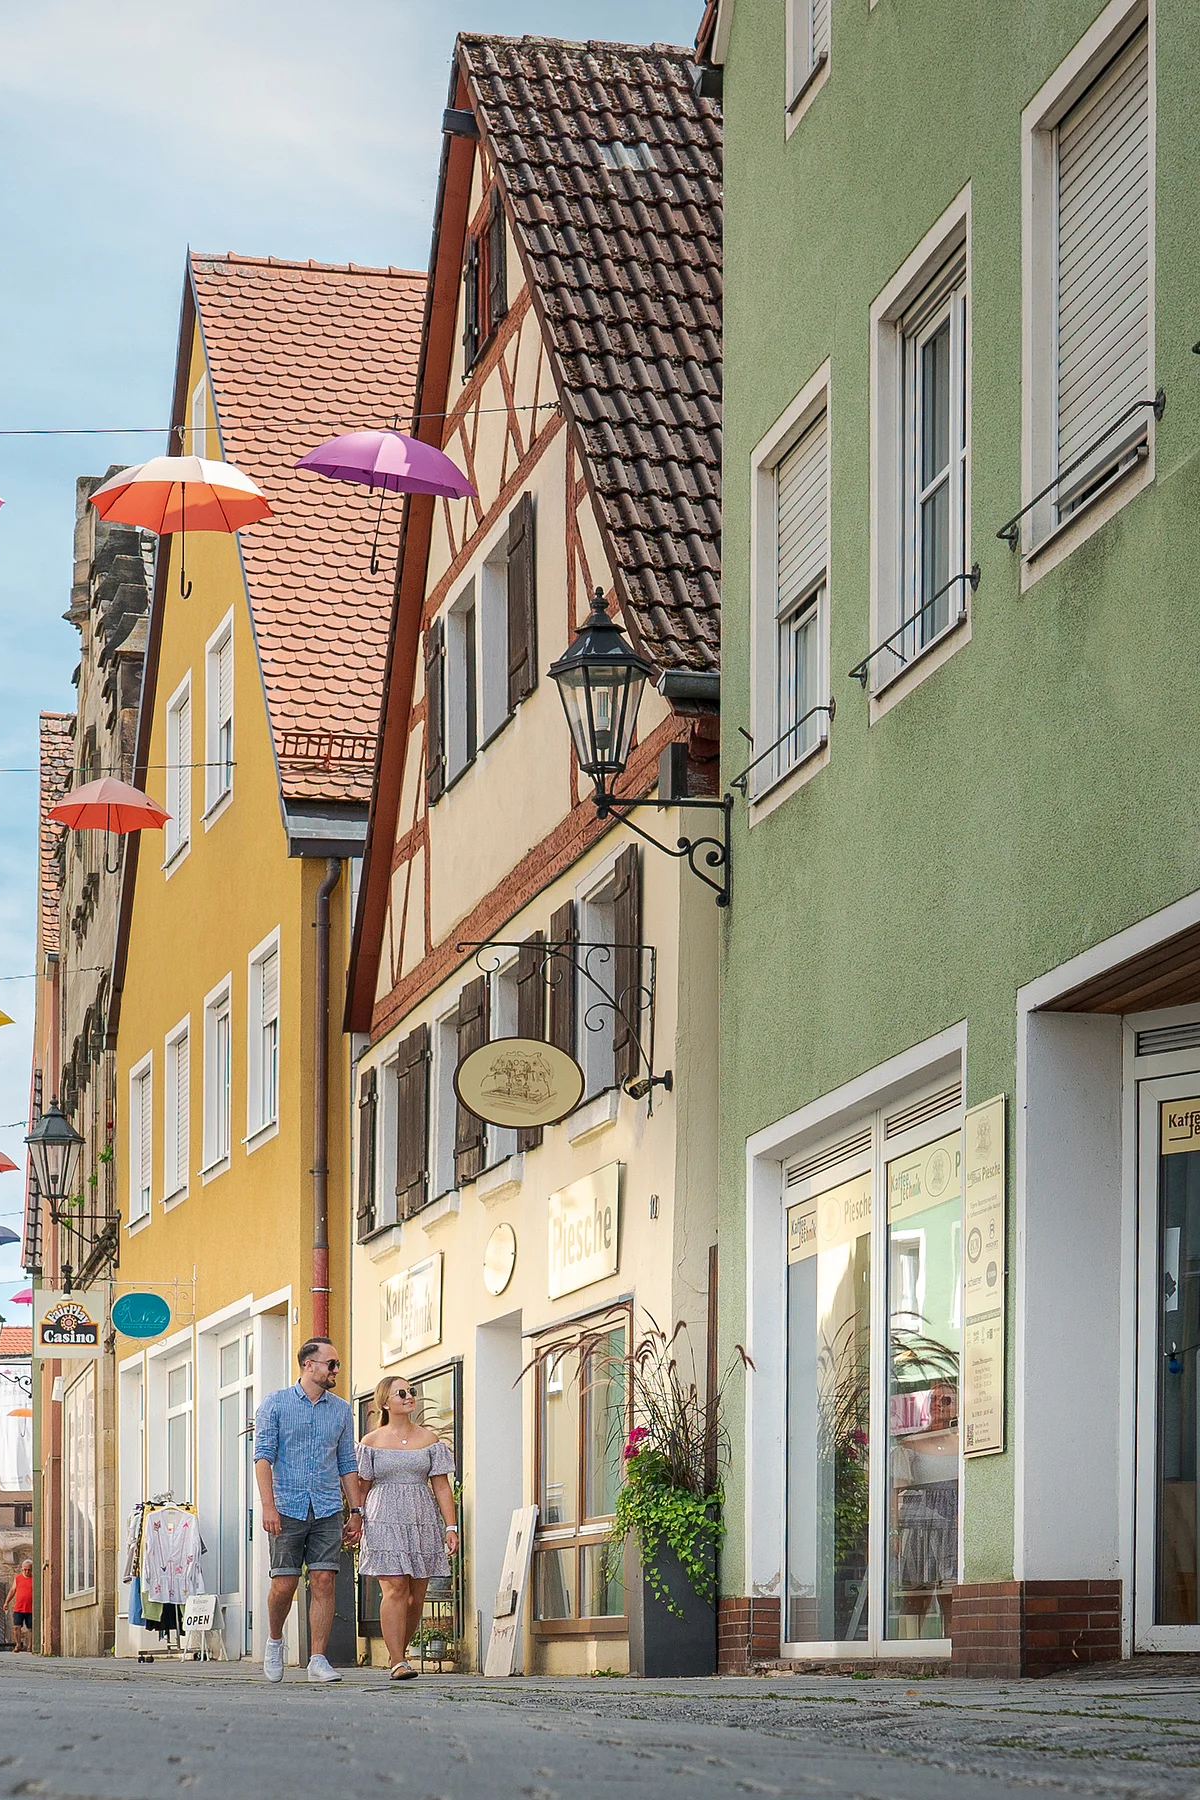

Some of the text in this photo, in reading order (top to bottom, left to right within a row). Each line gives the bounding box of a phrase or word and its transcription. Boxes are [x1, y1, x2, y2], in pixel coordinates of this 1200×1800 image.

[1168, 1111, 1200, 1129] Kaffe
[844, 1192, 872, 1224] Piesche
[553, 1197, 612, 1272] Piesche
[46, 1304, 90, 1324] FairPlay
[43, 1329, 95, 1344] Casino
[186, 1615, 210, 1626] OPEN
